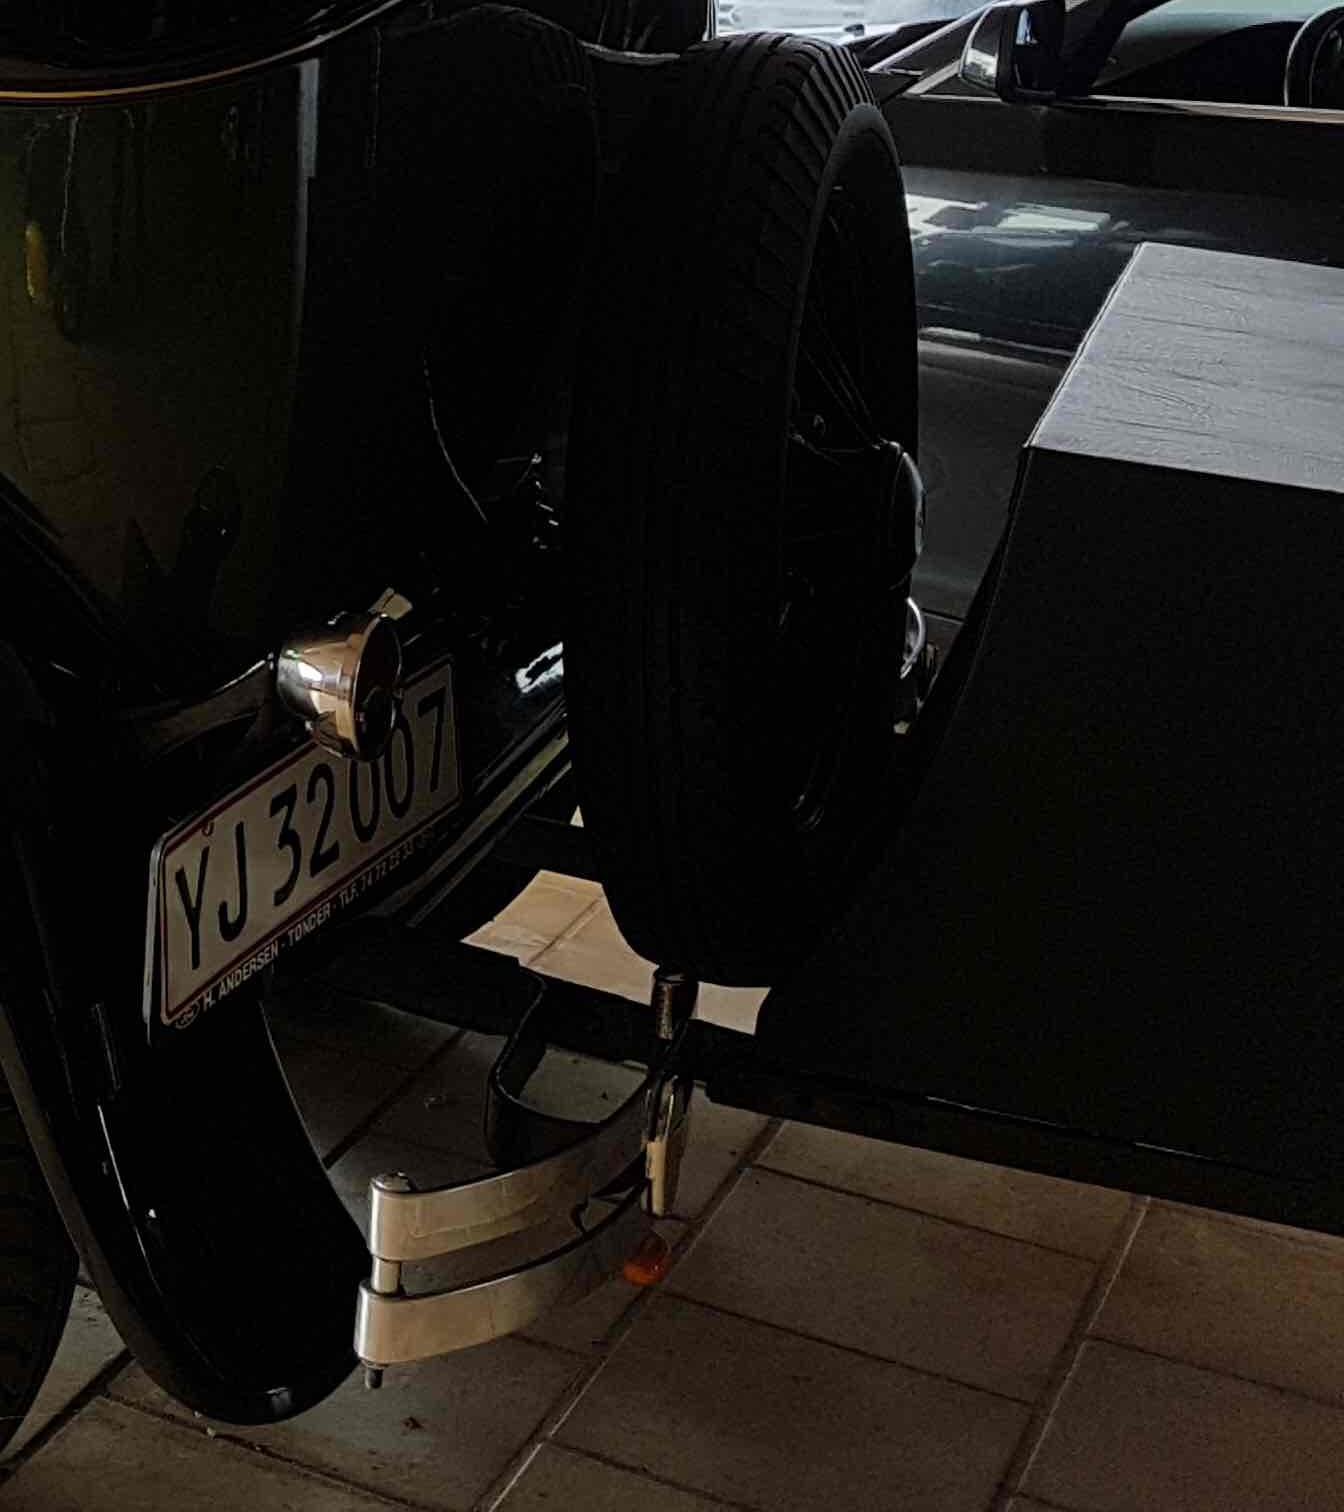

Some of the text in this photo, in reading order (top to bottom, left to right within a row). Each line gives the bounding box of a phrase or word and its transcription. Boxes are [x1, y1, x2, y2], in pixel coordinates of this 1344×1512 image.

[175, 686, 448, 970] YJ 32007
[218, 940, 279, 1000] ANDERSEN
